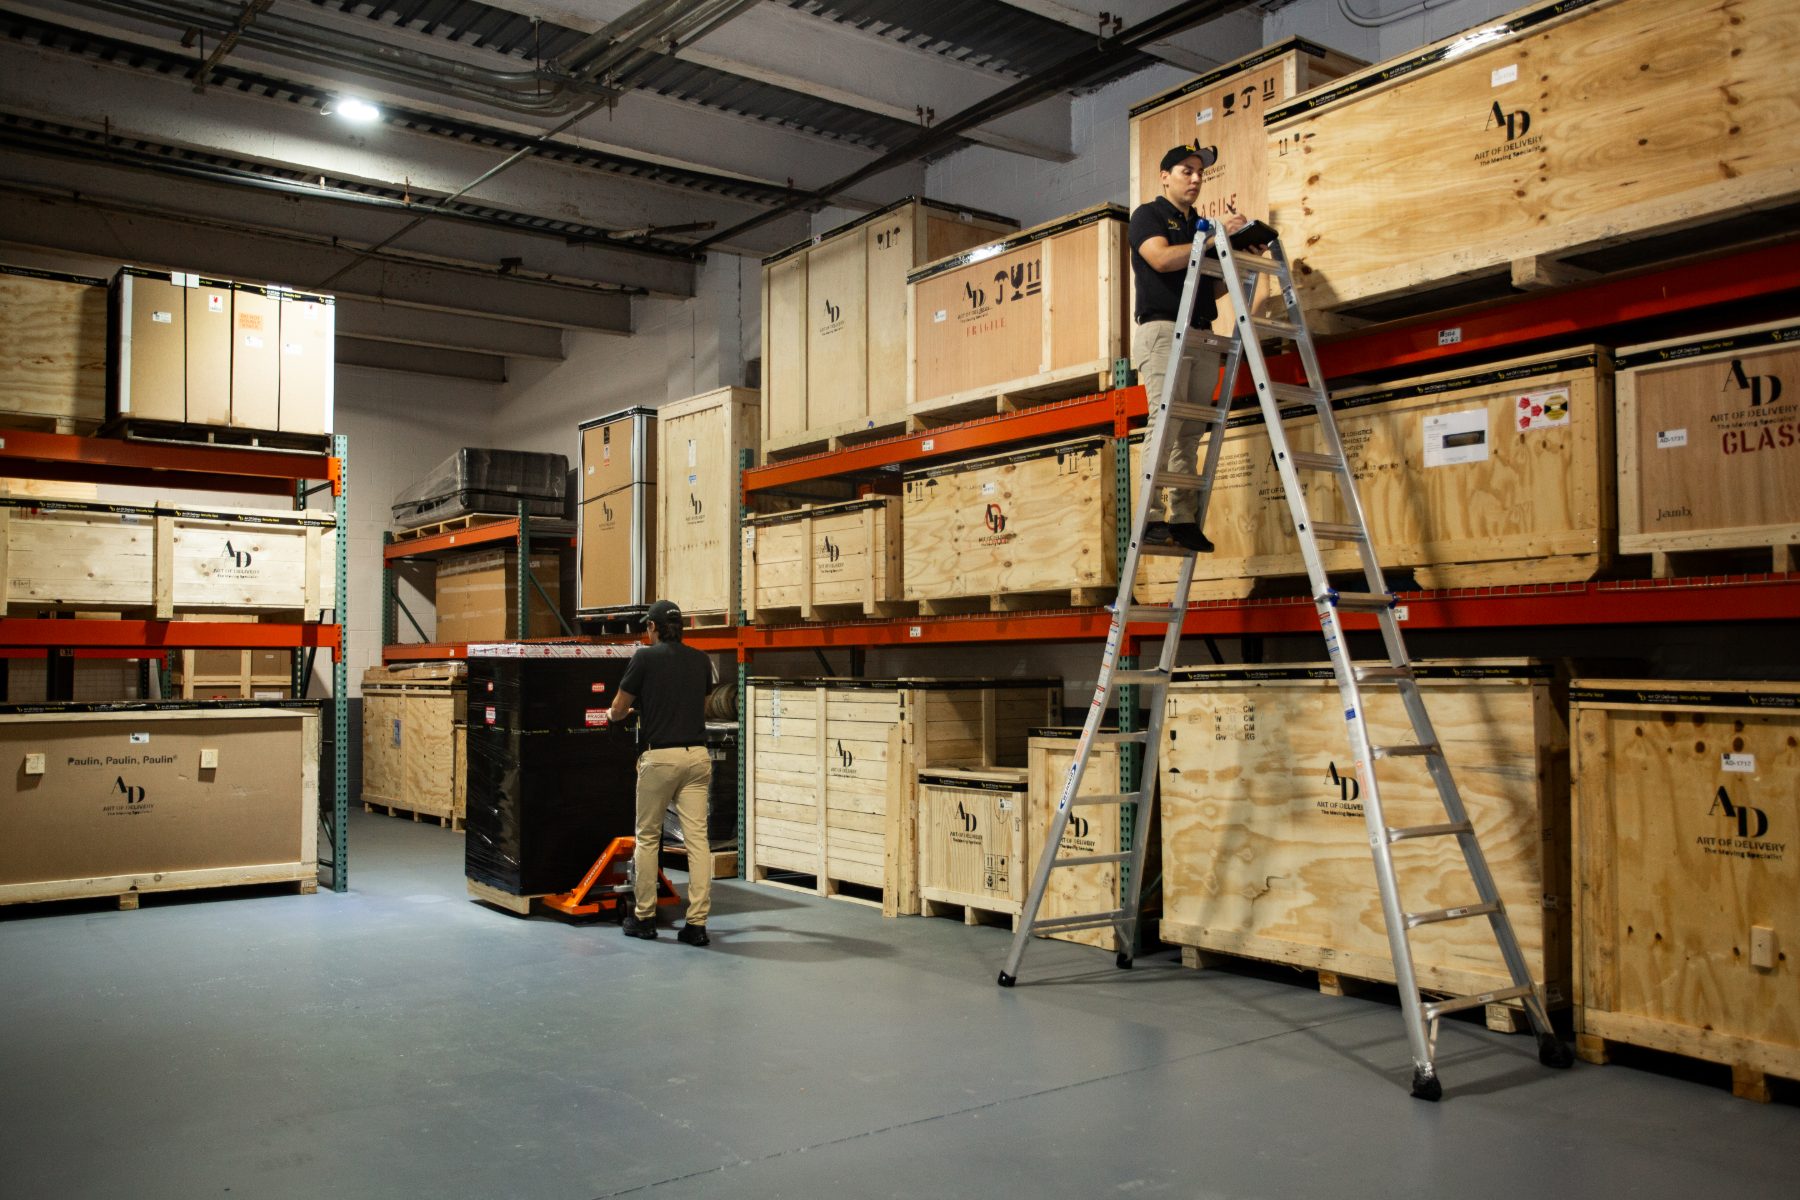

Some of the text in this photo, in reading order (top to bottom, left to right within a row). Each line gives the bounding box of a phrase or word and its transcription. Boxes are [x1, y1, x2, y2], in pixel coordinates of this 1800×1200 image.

[1485, 100, 1531, 142] AD
[1474, 134, 1543, 160] ART OF DELIVERY
[1491, 155, 1511, 164] Moving
[1513, 146, 1541, 157] Specialist
[962, 281, 985, 309] AD
[824, 299, 840, 323] AD
[1720, 359, 1782, 407] AD
[1710, 404, 1798, 422] ART OF DELIVERY
[1731, 419, 1757, 428] Moving
[1722, 423, 1800, 455] GLAS
[221, 540, 252, 568] AD
[1244, 733, 1255, 741] KG
[67, 757, 103, 766] Paulin,
[106, 756, 140, 765] Paulin,
[835, 739, 853, 767] AD
[111, 775, 145, 804] AD
[1323, 761, 1359, 801] AD
[954, 800, 977, 832] AD
[1707, 785, 1768, 838] AD
[1696, 836, 1786, 852] ART OF DELIVERY
[1717, 849, 1744, 858] Moving
[1746, 852, 1782, 861] Specialist
